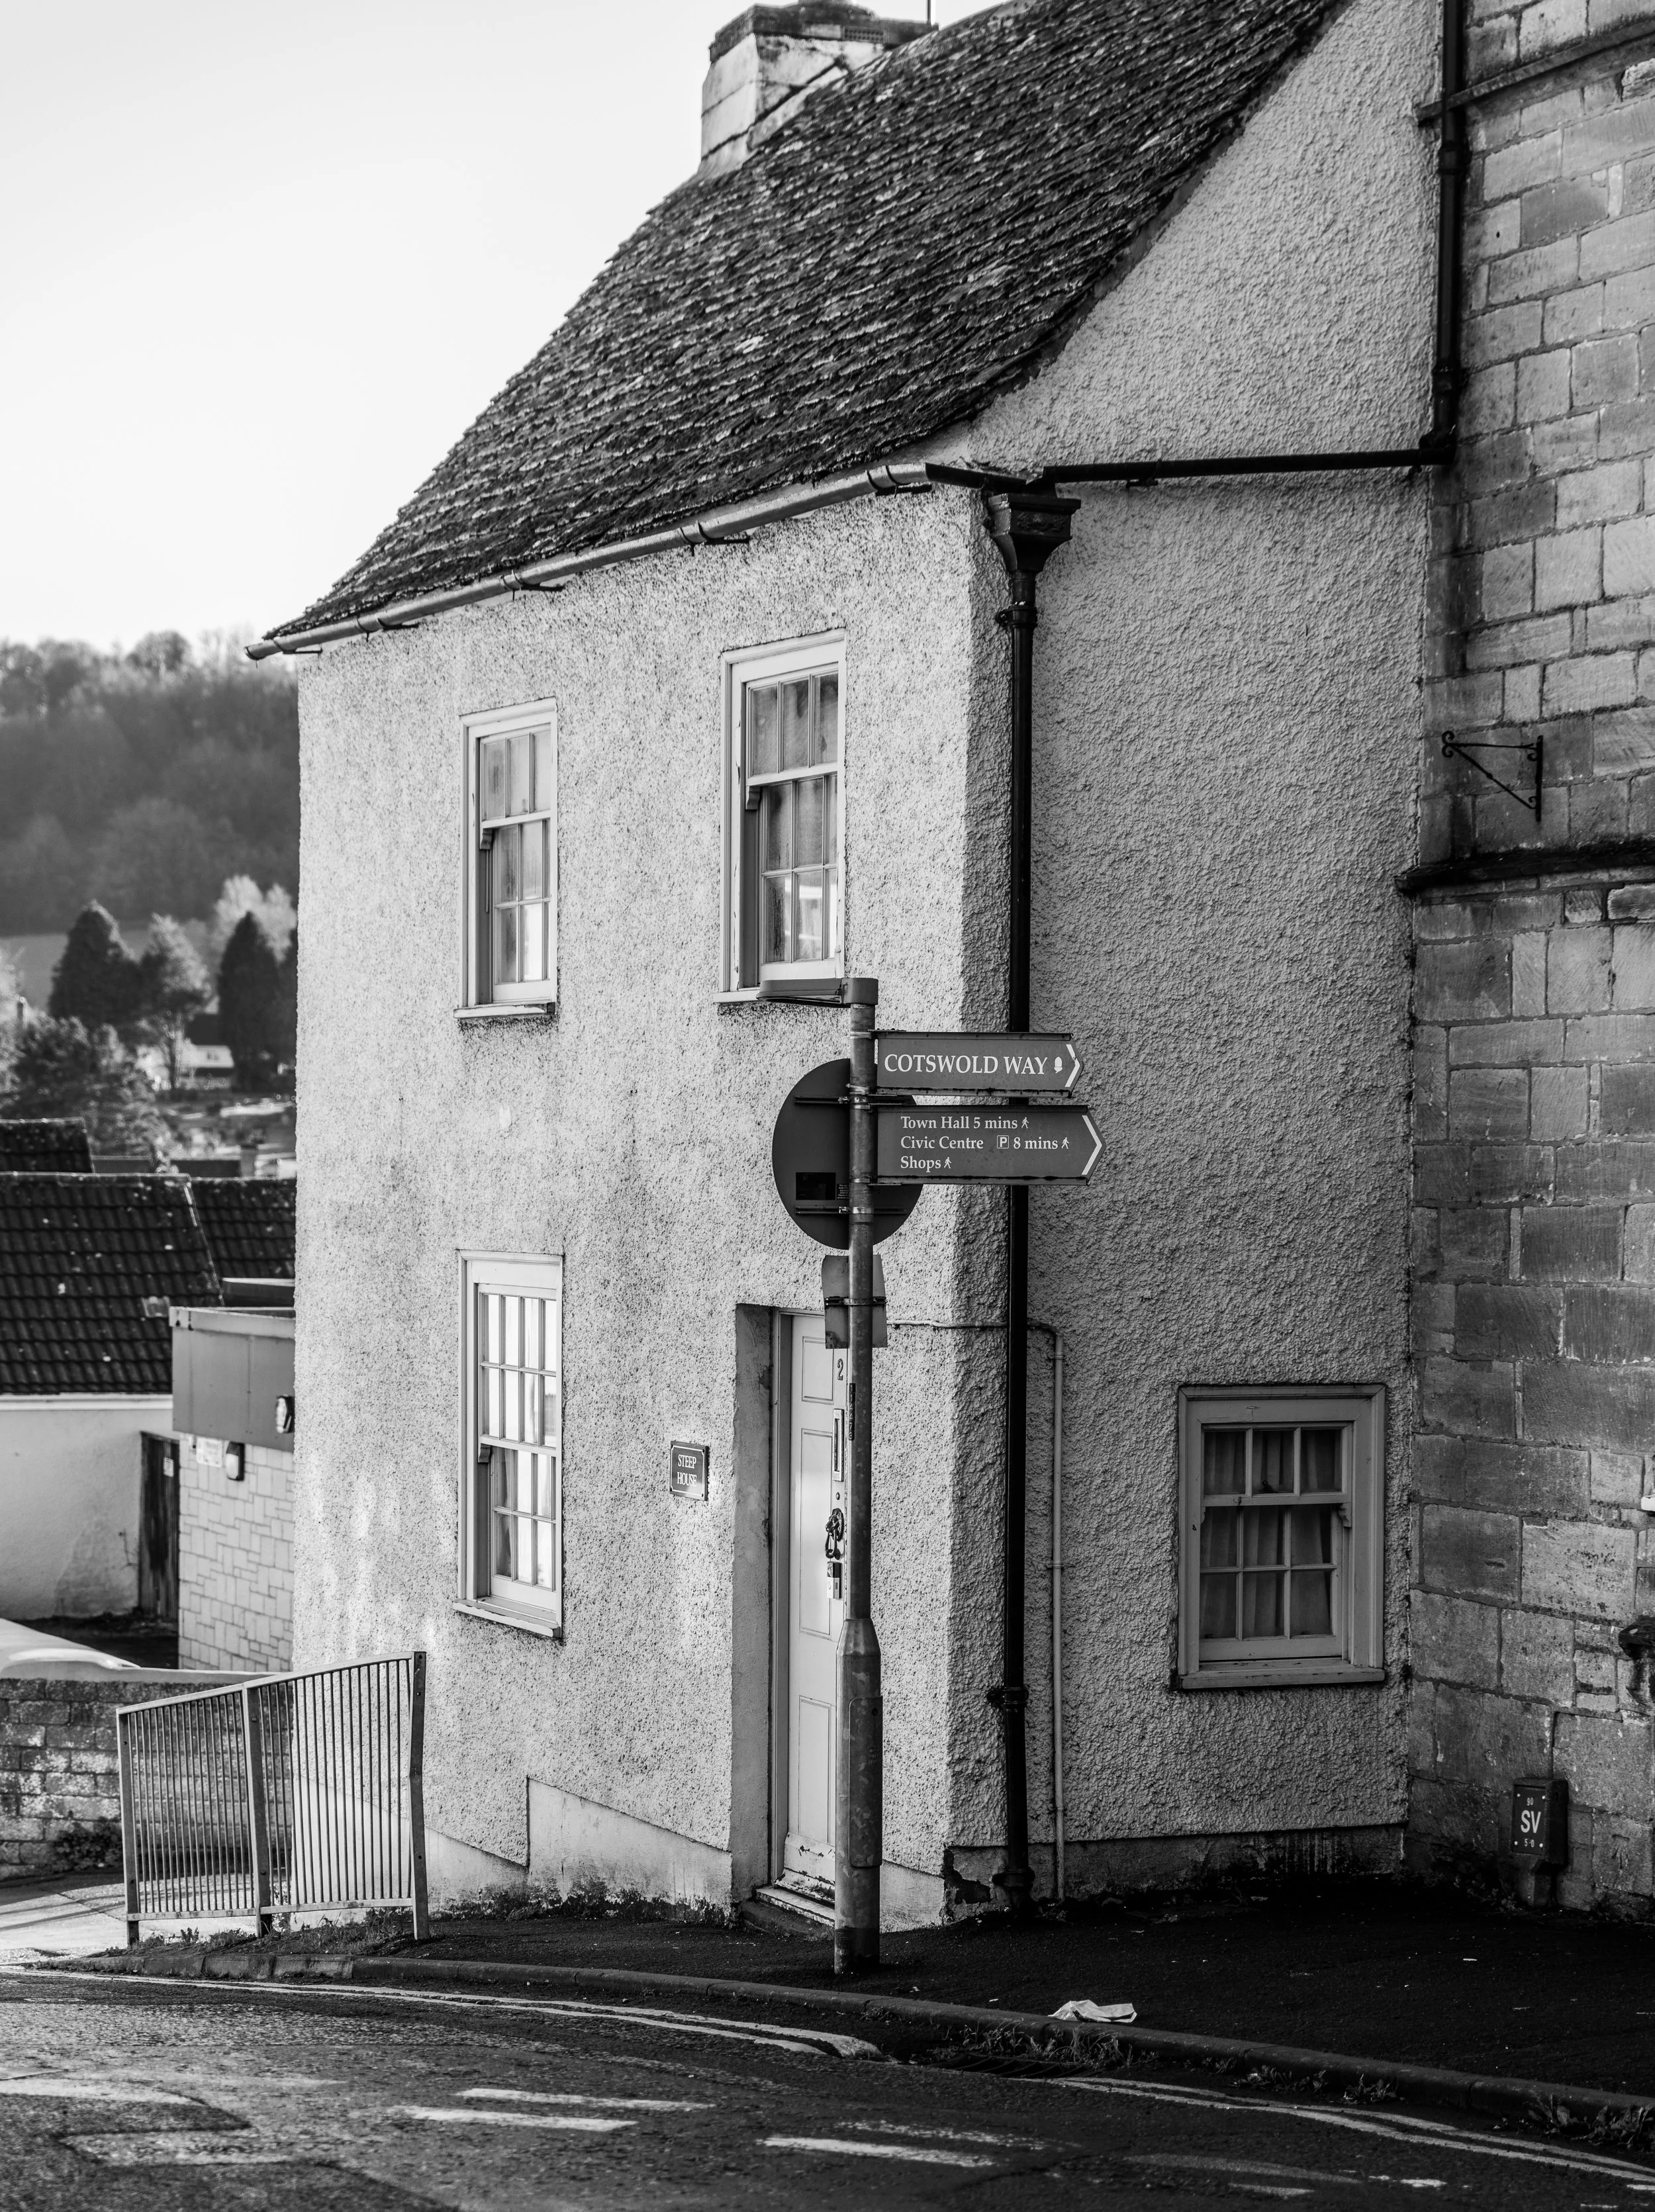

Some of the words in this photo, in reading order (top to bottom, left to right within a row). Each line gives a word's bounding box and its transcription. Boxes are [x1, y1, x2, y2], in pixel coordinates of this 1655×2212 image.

[884, 1054, 998, 1074] COTSWOLD
[1003, 1056, 1048, 1075] WAY
[900, 1116, 937, 1129] Town
[941, 1116, 970, 1129] Hall
[973, 1117, 980, 1129] 5
[984, 1116, 1018, 1129] mins
[900, 1136, 935, 1149] Civic
[939, 1136, 984, 1149] Centre
[1014, 1136, 1021, 1149] 8
[1024, 1136, 1059, 1150] mins
[900, 1156, 941, 1173] Shops
[837, 1358, 843, 1381] 2
[678, 1454, 697, 1469] STEEP
[677, 1471, 697, 1487] HOUSE
[1527, 1797, 1534, 1806] 90
[1521, 1810, 1542, 1833] SV
